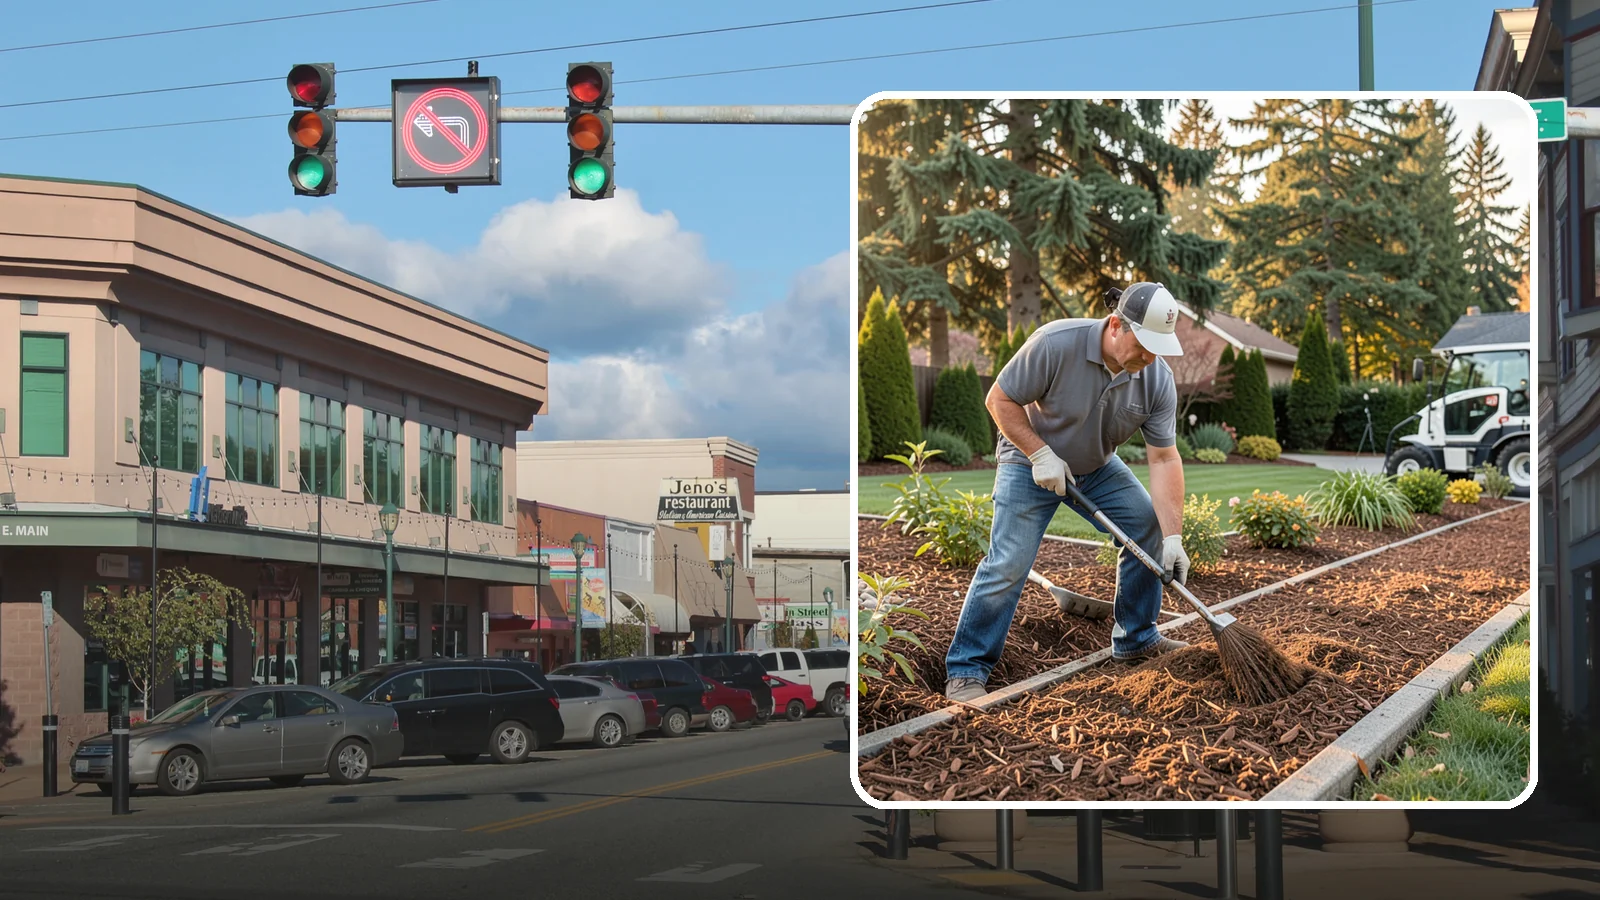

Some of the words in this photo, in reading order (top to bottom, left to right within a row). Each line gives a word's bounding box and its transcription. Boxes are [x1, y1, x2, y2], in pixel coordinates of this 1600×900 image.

[669, 479, 728, 495] Jeno's
[664, 496, 731, 509] restaurant
[658, 509, 682, 519] Italian
[686, 509, 714, 519] American
[714, 509, 738, 519] Cuisine
[2, 525, 13, 536] E.
[15, 525, 49, 536] MAIN
[797, 607, 828, 617] Street
